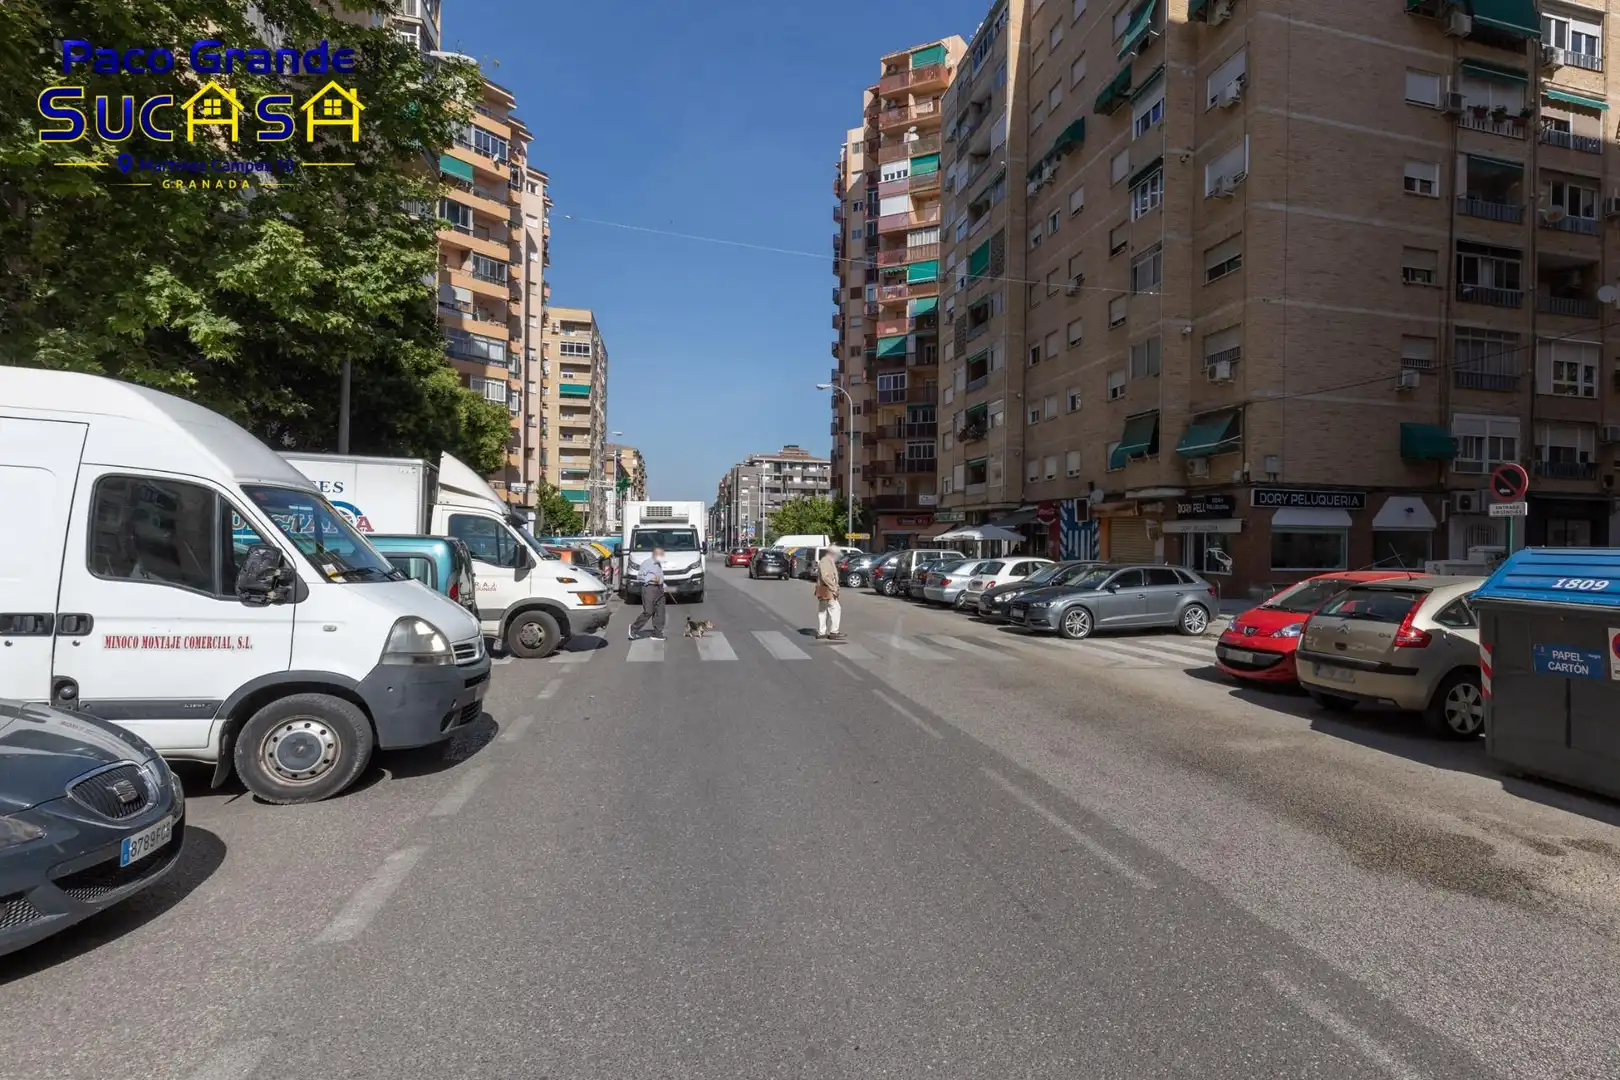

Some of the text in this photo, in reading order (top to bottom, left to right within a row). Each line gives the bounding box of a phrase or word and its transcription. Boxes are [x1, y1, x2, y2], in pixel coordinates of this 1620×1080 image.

[312, 481, 344, 493] ES
[1260, 492, 1360, 506] DORY PELUQUERIA
[1552, 577, 1610, 591] 1809
[104, 635, 253, 651] MINOCO MONTAJE COMERCIAL, S.L.
[1552, 650, 1585, 662] PAPEL
[1548, 661, 1589, 676] CARTÓN
